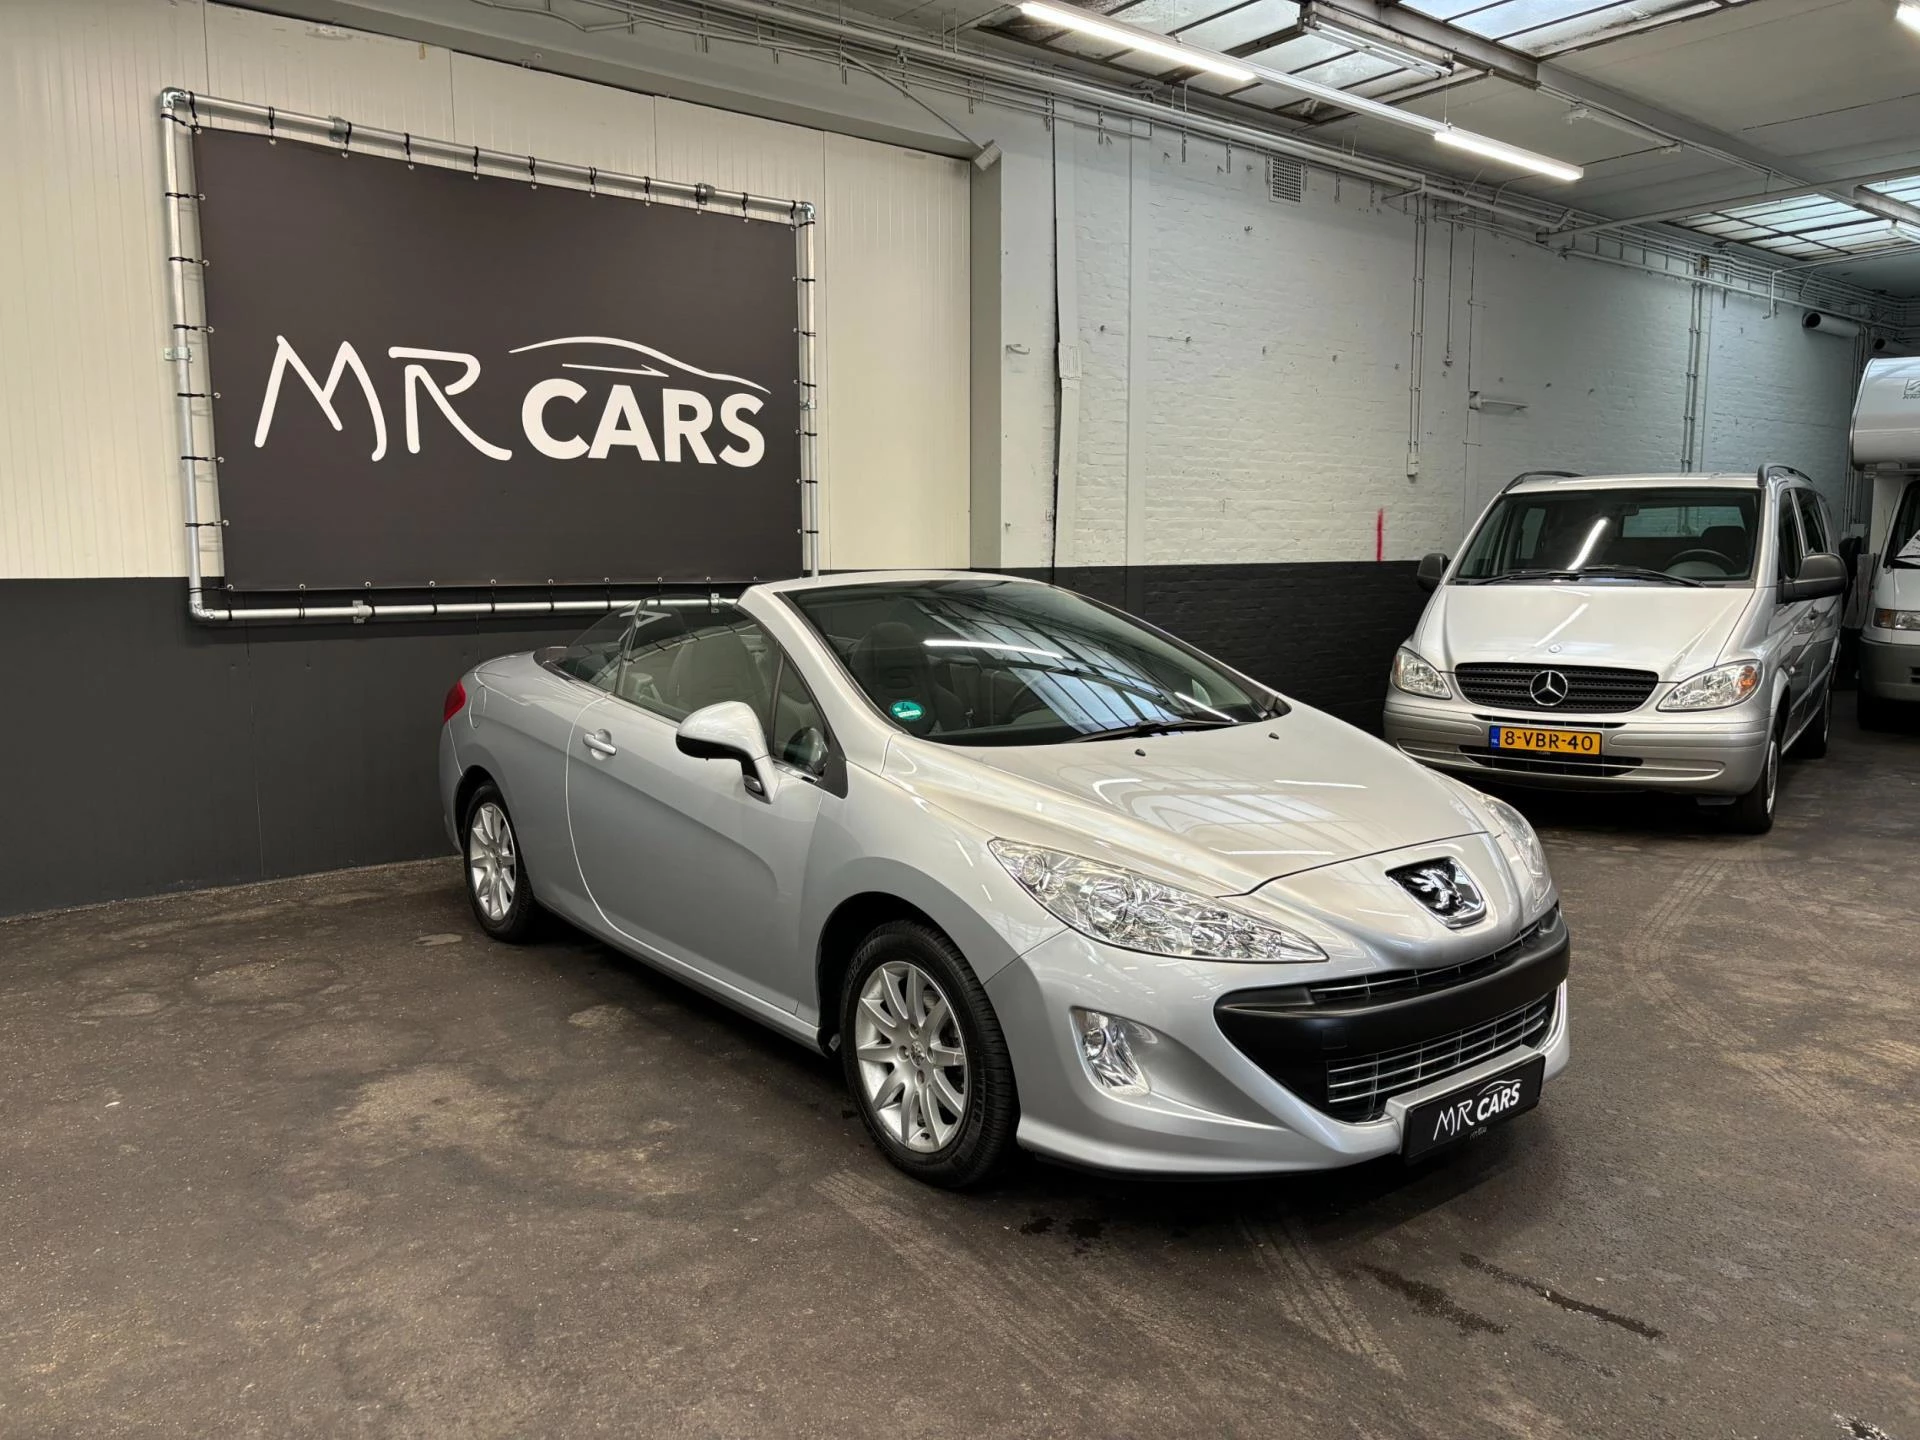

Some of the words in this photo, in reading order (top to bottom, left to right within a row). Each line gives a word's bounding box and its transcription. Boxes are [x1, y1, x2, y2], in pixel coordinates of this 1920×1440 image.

[254, 334, 513, 462] MR
[521, 378, 765, 468] CARS
[1504, 730, 1593, 751] 8-VBR-40
[1433, 1100, 1475, 1141] MR
[1476, 1082, 1521, 1121] CARS
